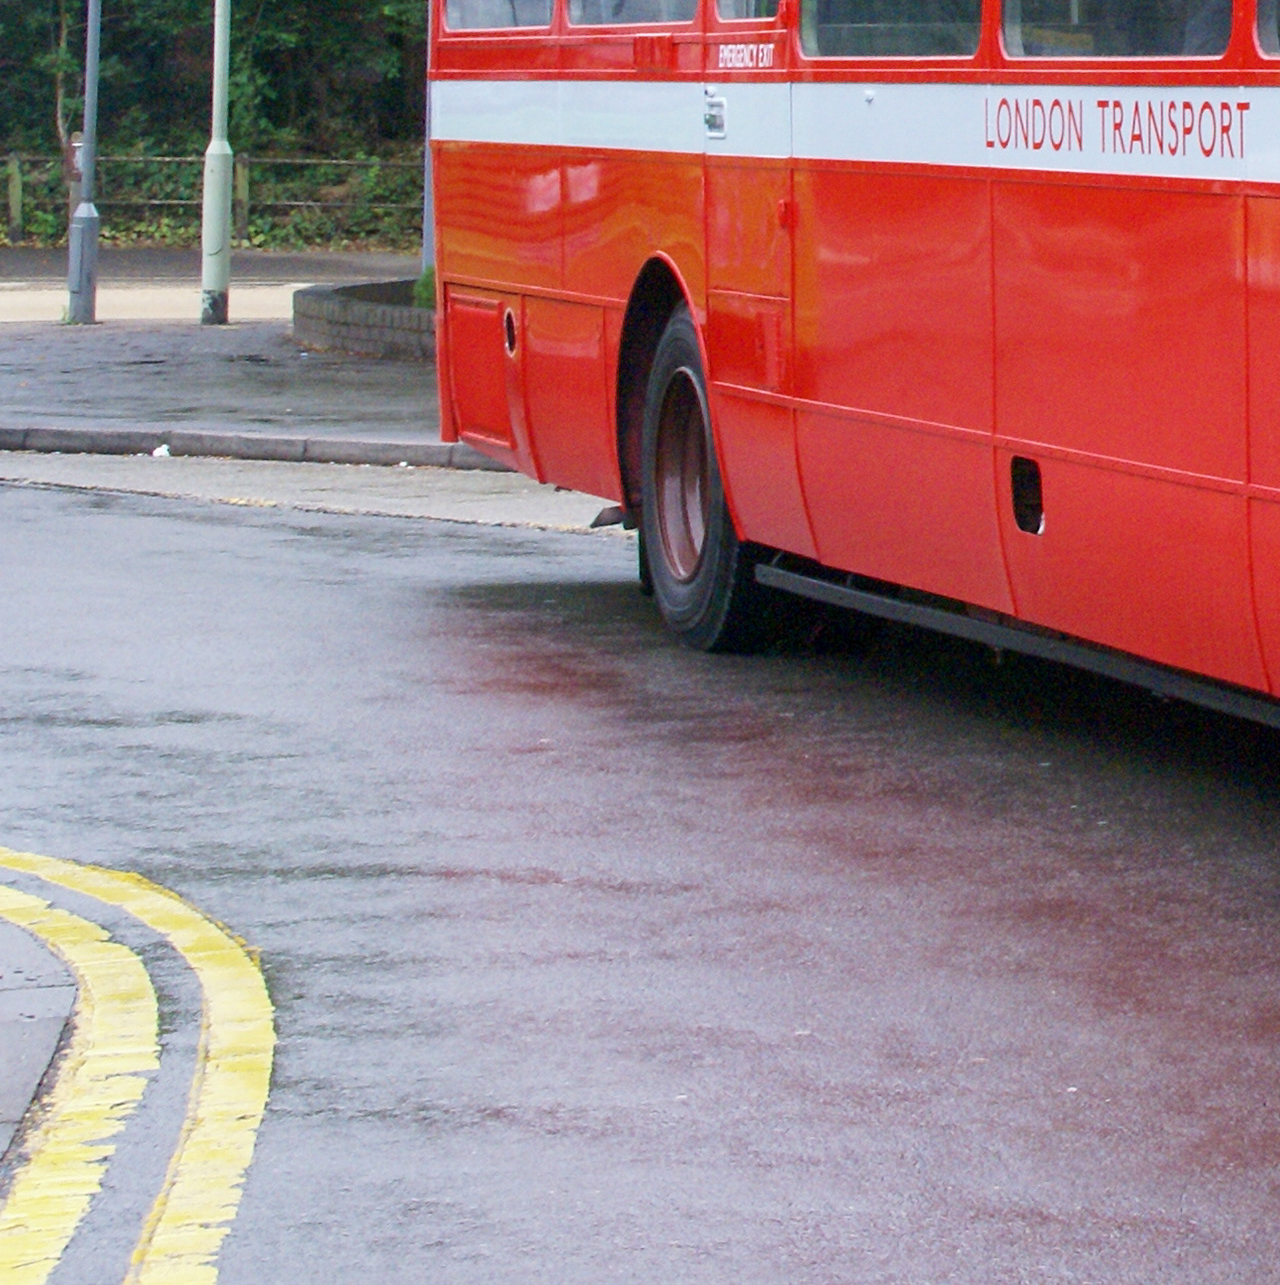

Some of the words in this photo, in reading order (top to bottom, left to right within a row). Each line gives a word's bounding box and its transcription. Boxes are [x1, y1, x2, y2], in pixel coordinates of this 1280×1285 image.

[718, 43, 757, 68] EMERGENCY
[758, 44, 775, 68] EXIT
[985, 97, 1083, 151] LONDON
[1096, 100, 1251, 158] TRANSPORT
